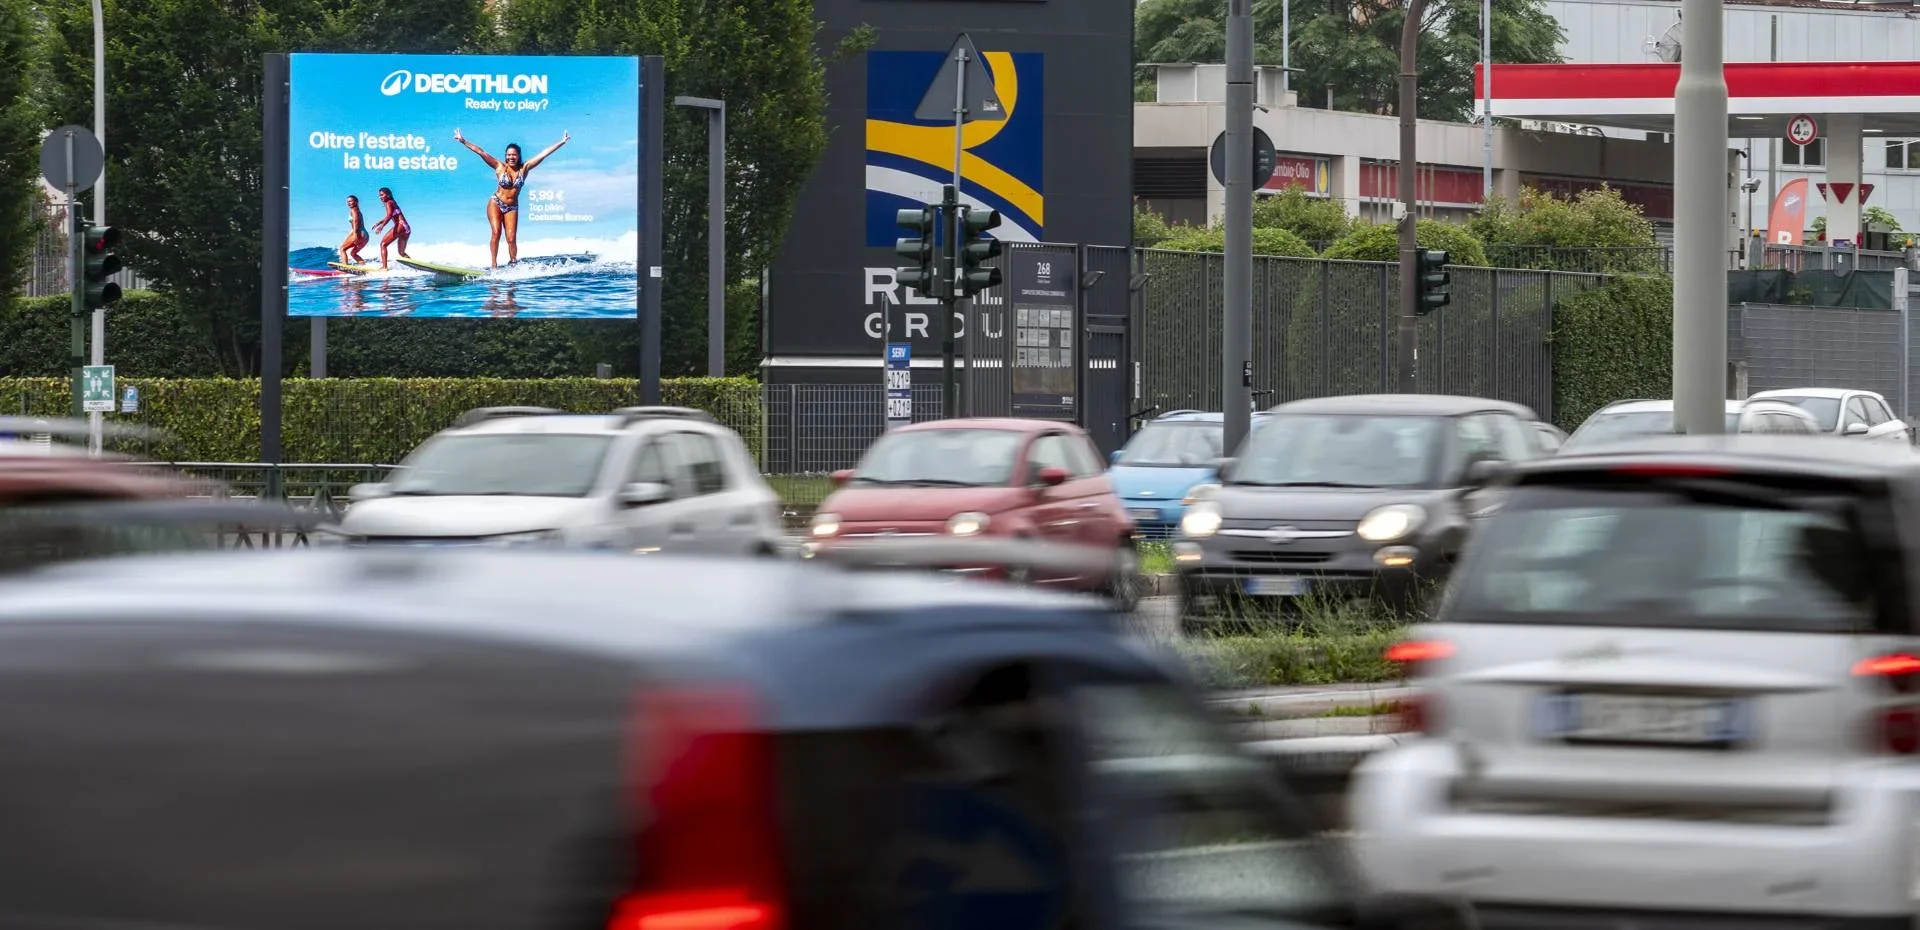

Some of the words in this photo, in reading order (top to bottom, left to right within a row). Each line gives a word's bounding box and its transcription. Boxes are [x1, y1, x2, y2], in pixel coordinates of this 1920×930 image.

[415, 74, 547, 94] DECATHLON
[465, 98, 501, 111] Ready
[503, 100, 515, 110] to
[518, 99, 548, 112] play?
[309, 131, 355, 149] Oltre
[359, 132, 430, 153] l'estate,
[343, 152, 360, 169] la
[364, 153, 394, 169] tua
[398, 154, 458, 170] estate
[1272, 162, 1294, 177] ambio
[528, 190, 553, 202] 5,99
[1037, 262, 1051, 275] 268
